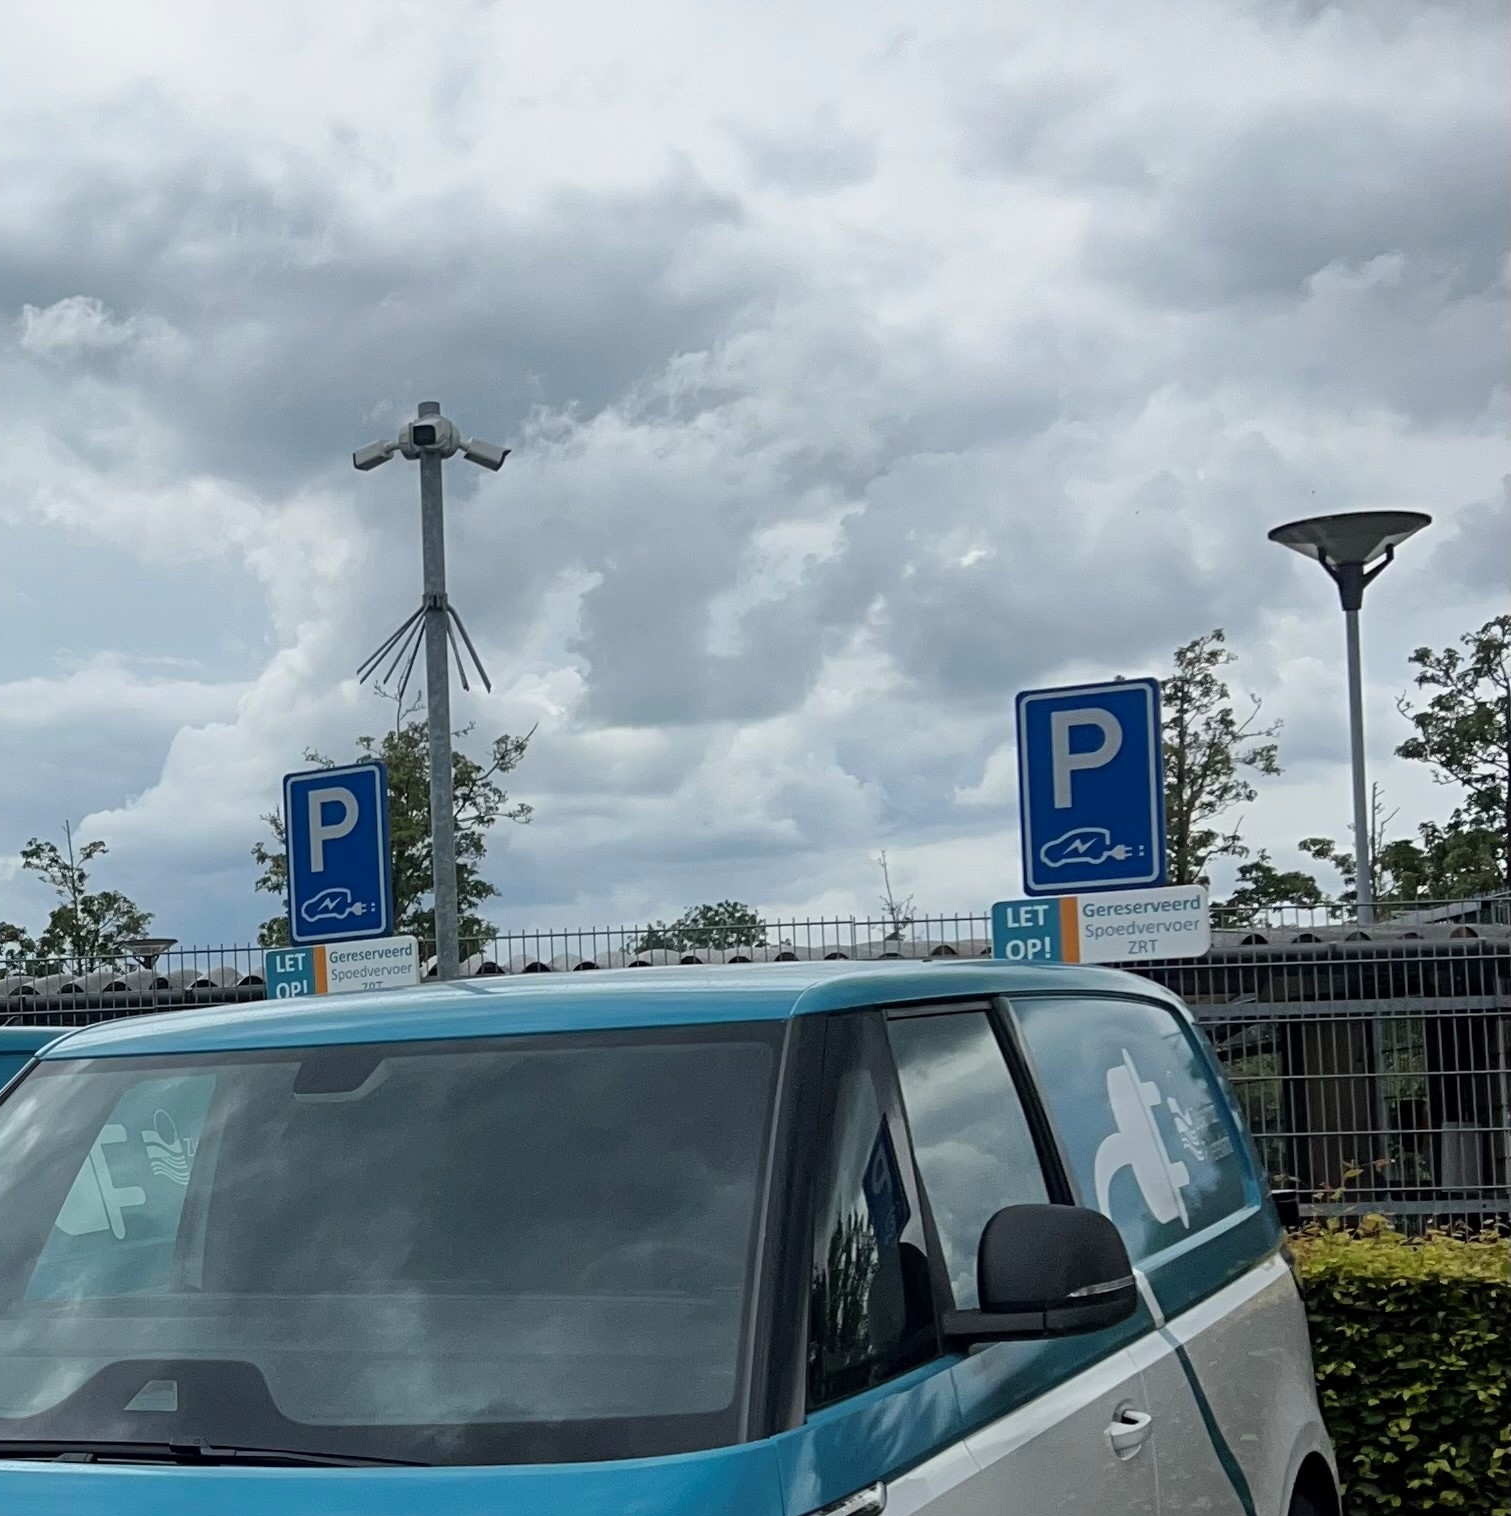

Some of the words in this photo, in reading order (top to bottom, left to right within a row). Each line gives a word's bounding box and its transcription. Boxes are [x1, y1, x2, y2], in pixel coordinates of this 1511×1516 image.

[1050, 707, 1123, 809] P
[308, 786, 359, 873] P
[1006, 905, 1049, 928] LET
[1082, 894, 1201, 918] Gereserveerd
[1085, 919, 1200, 939] Spoedvervoer
[329, 943, 413, 964] Gereserveerd
[1005, 936, 1051, 960] OP!
[1128, 939, 1159, 954] ZRT
[275, 953, 306, 973] LET
[331, 963, 413, 983] Spoedvervoer
